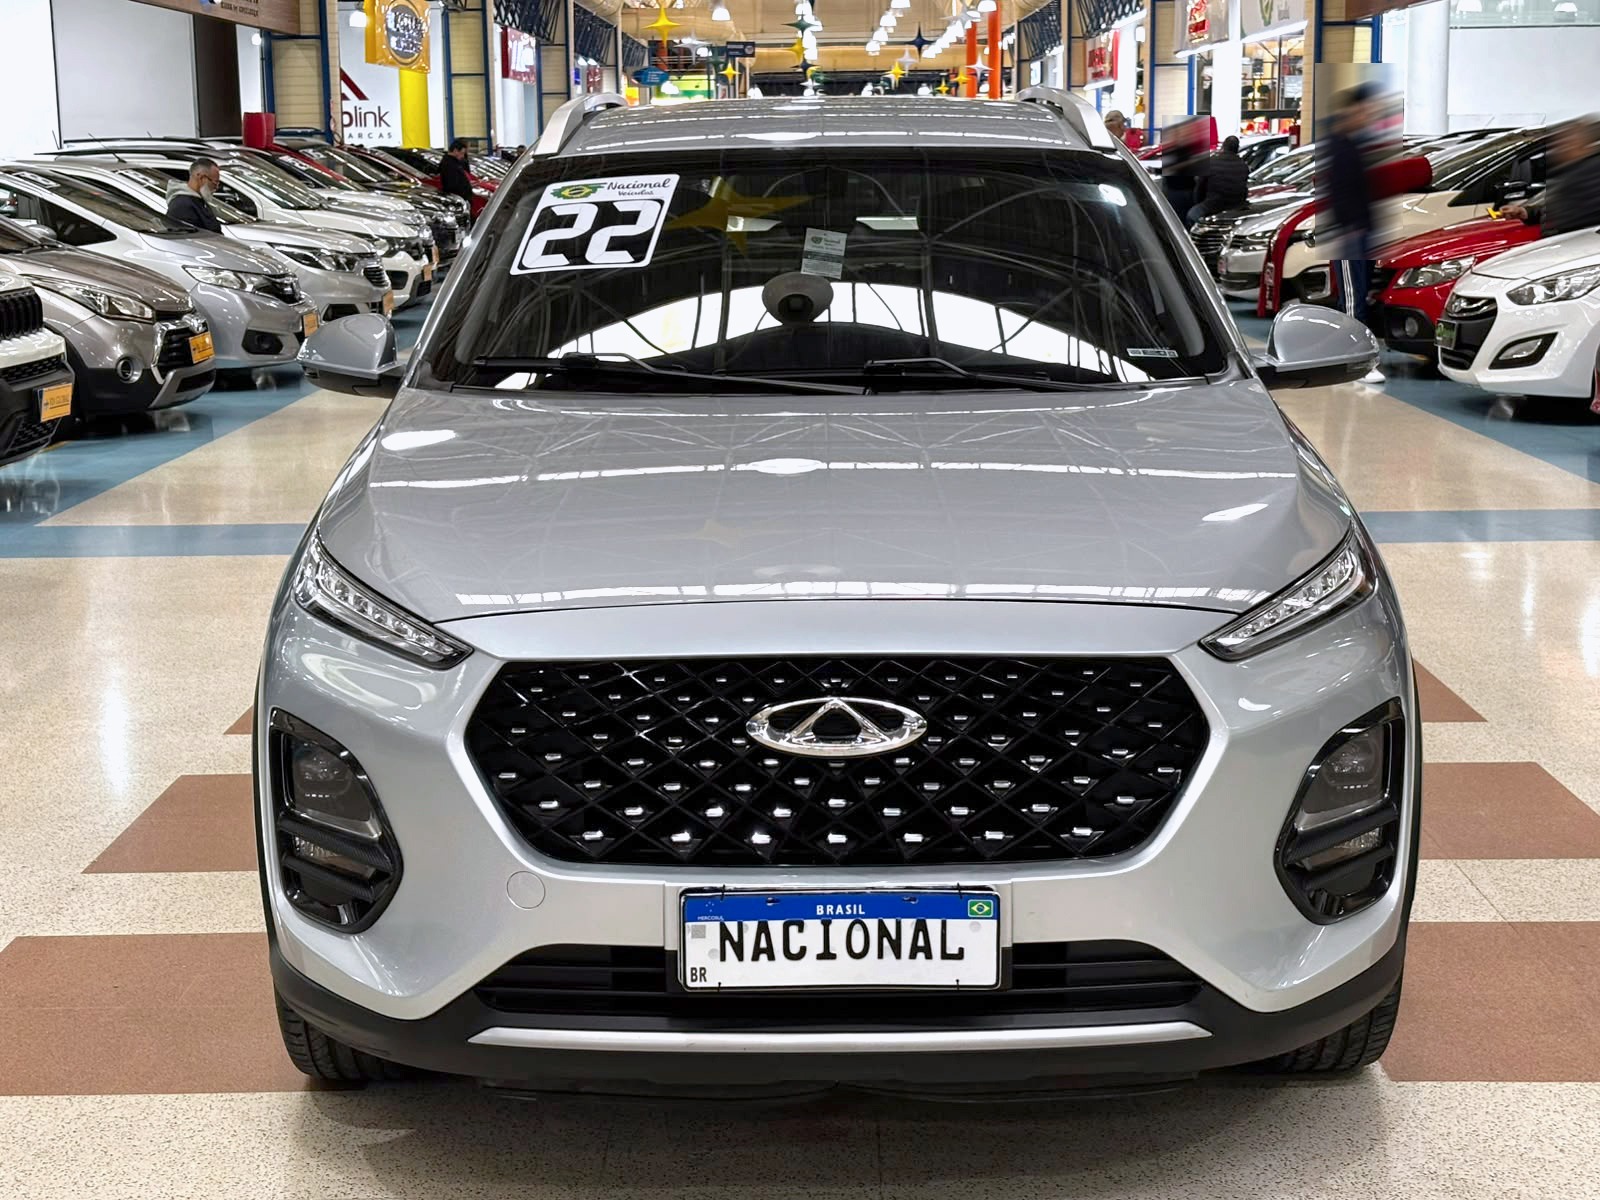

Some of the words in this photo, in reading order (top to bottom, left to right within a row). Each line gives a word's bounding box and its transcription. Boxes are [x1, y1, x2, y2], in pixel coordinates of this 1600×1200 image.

[607, 178, 671, 190] Nacional
[521, 200, 661, 268] 22
[816, 904, 865, 915] BRASIL
[719, 919, 964, 962] NACIONAL
[690, 967, 707, 982] BR
